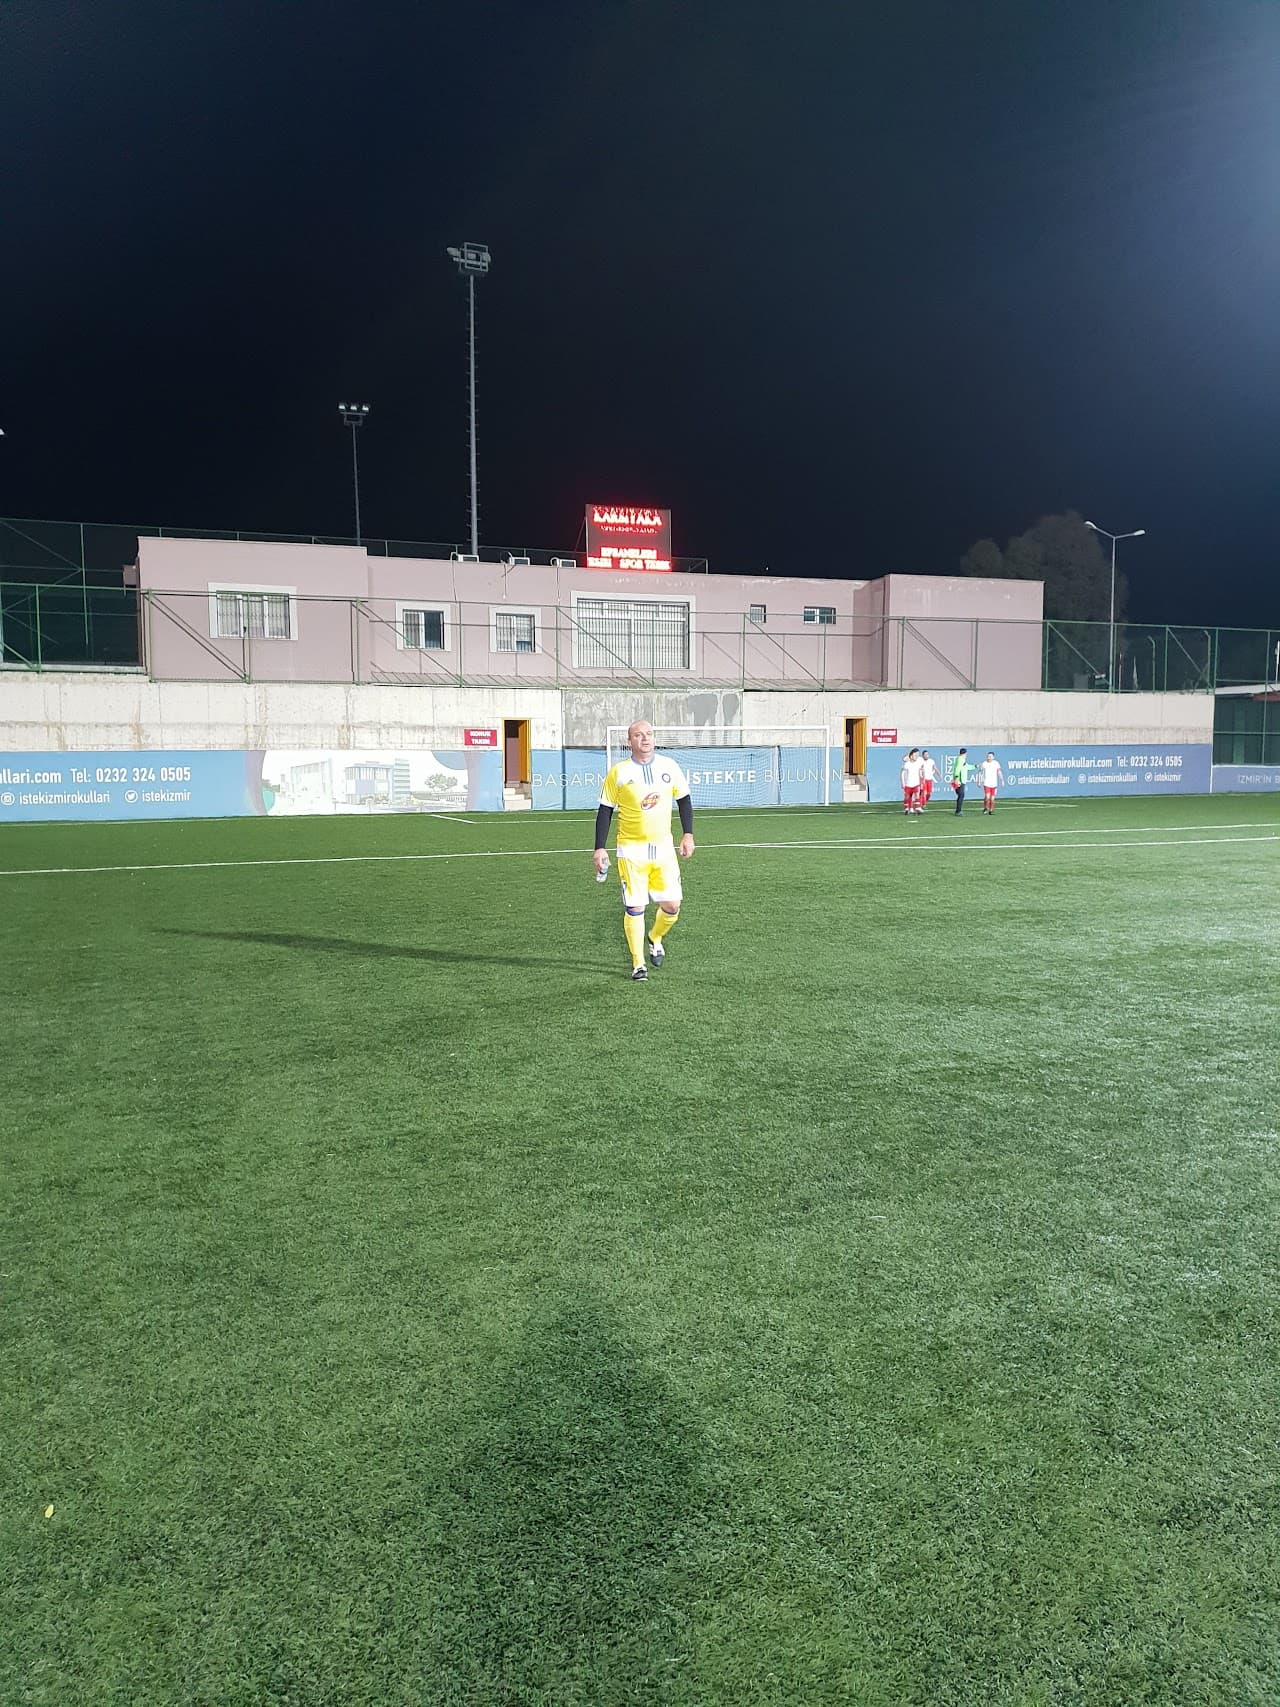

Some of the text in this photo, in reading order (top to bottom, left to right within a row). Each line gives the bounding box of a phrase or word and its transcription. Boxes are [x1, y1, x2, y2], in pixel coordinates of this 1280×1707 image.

[1117, 755, 1129, 767] Tel:
[1130, 755, 1148, 767] 0232
[1165, 755, 1183, 767] 0505
[70, 768, 91, 783] Tel:
[96, 767, 127, 783] 0232
[132, 767, 155, 782] 324
[160, 766, 191, 782] 0505
[19, 791, 111, 805] istekizmirokullari
[141, 789, 191, 803] istekizmir
